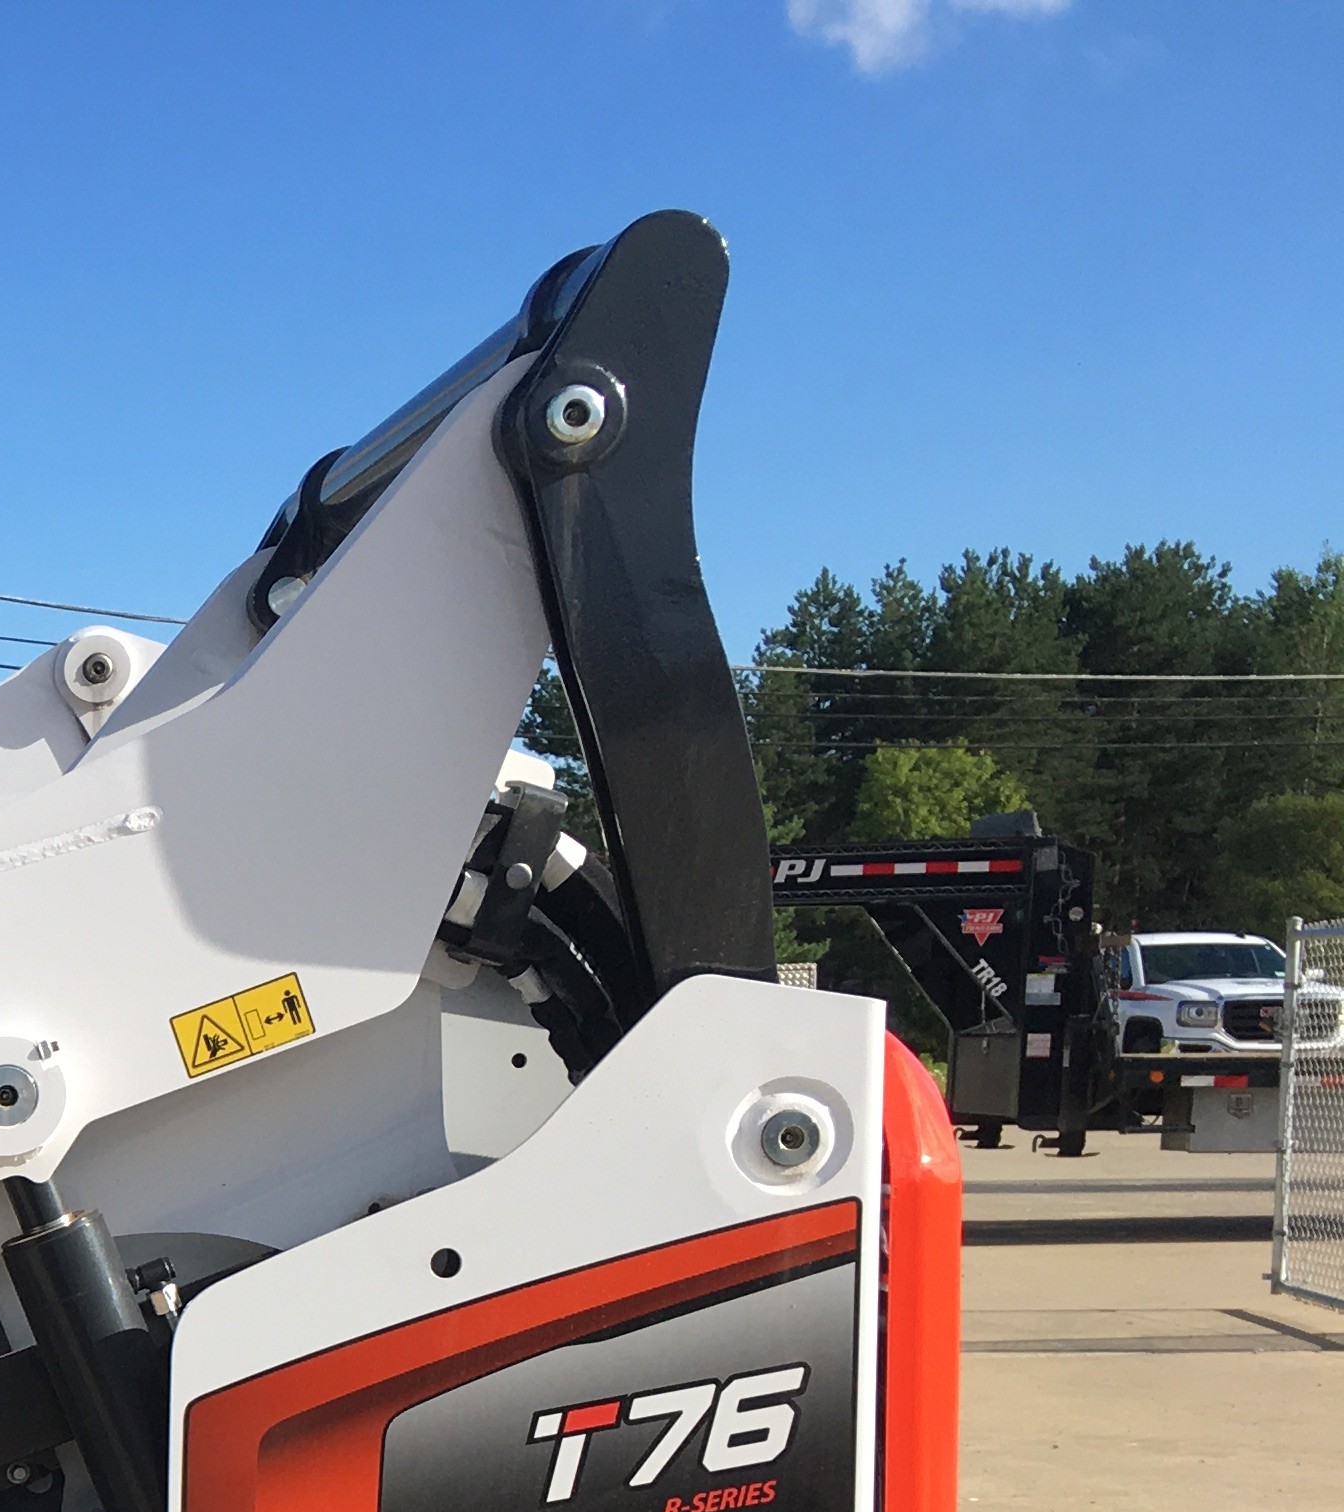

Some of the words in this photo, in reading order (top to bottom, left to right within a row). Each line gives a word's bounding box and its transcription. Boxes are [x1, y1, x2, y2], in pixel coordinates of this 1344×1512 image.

[774, 859, 827, 883] PJ
[972, 958, 1007, 997] TR18
[531, 1364, 807, 1505] T76
